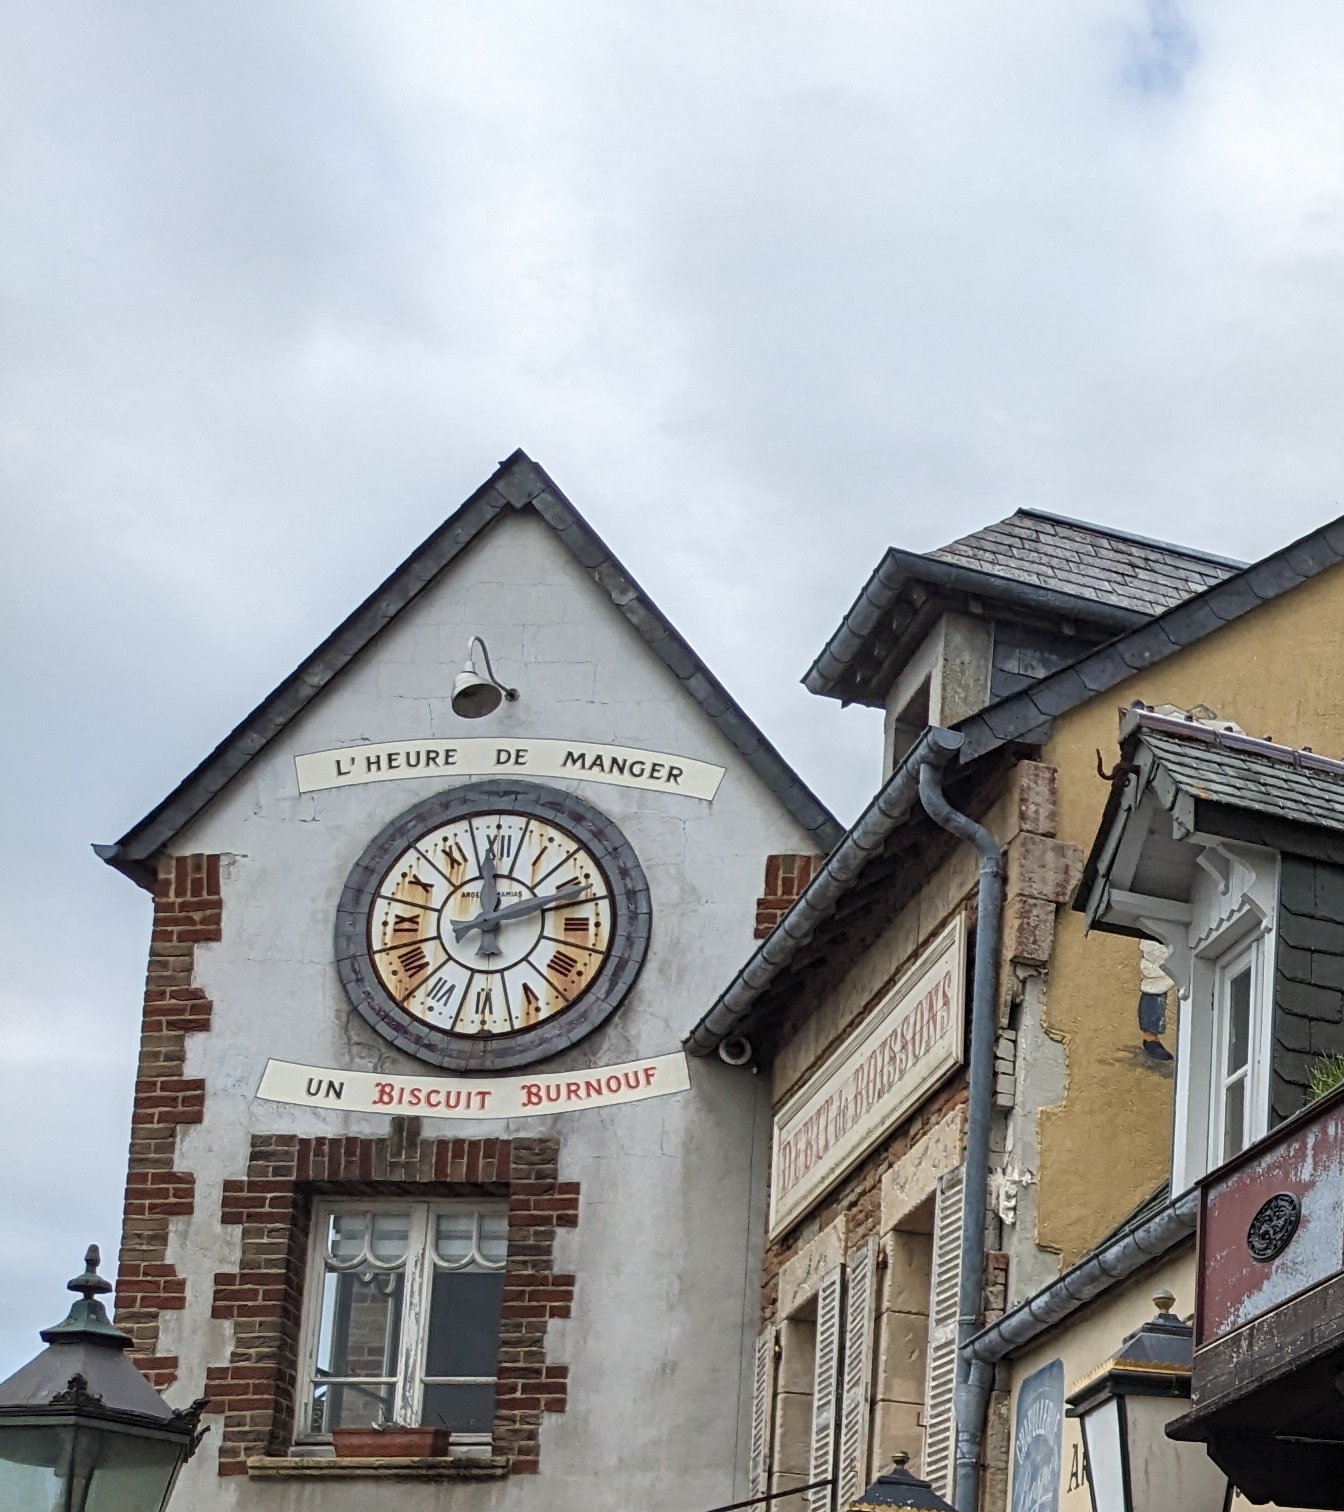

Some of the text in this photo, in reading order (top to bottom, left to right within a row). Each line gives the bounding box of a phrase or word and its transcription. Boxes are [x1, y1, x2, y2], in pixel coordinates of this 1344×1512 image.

[334, 748, 684, 785] L'HEURE DE MANGER
[852, 970, 952, 1123] BOISSONS
[306, 1077, 345, 1100] UN
